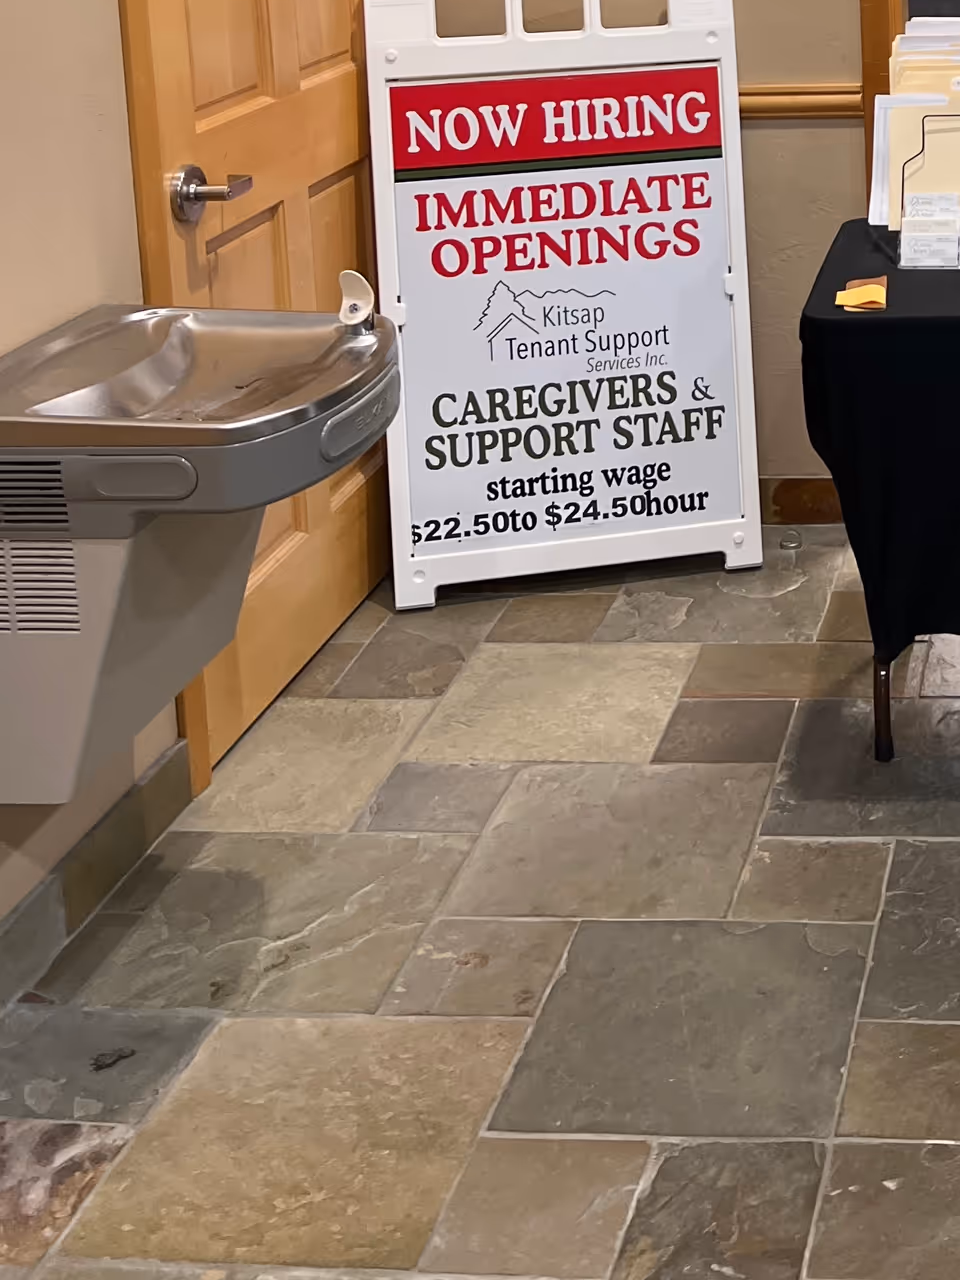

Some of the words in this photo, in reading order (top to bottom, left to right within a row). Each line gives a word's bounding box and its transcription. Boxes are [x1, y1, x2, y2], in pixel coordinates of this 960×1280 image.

[406, 103, 528, 153] NOW
[542, 92, 711, 143] HIRING
[413, 171, 712, 232] IMMEDIATE
[431, 218, 700, 277] OPENINGS
[505, 333, 578, 361] Tenant
[585, 325, 670, 356] Support
[543, 304, 605, 328] Kitsap
[586, 356, 641, 373] Services
[645, 352, 668, 368] Inc.
[432, 371, 678, 427] CAREGIVERS
[691, 377, 715, 401] &
[424, 418, 601, 470] SUPPORT
[612, 405, 726, 450] STAFF
[486, 467, 594, 501] starting
[601, 461, 671, 490] wage
